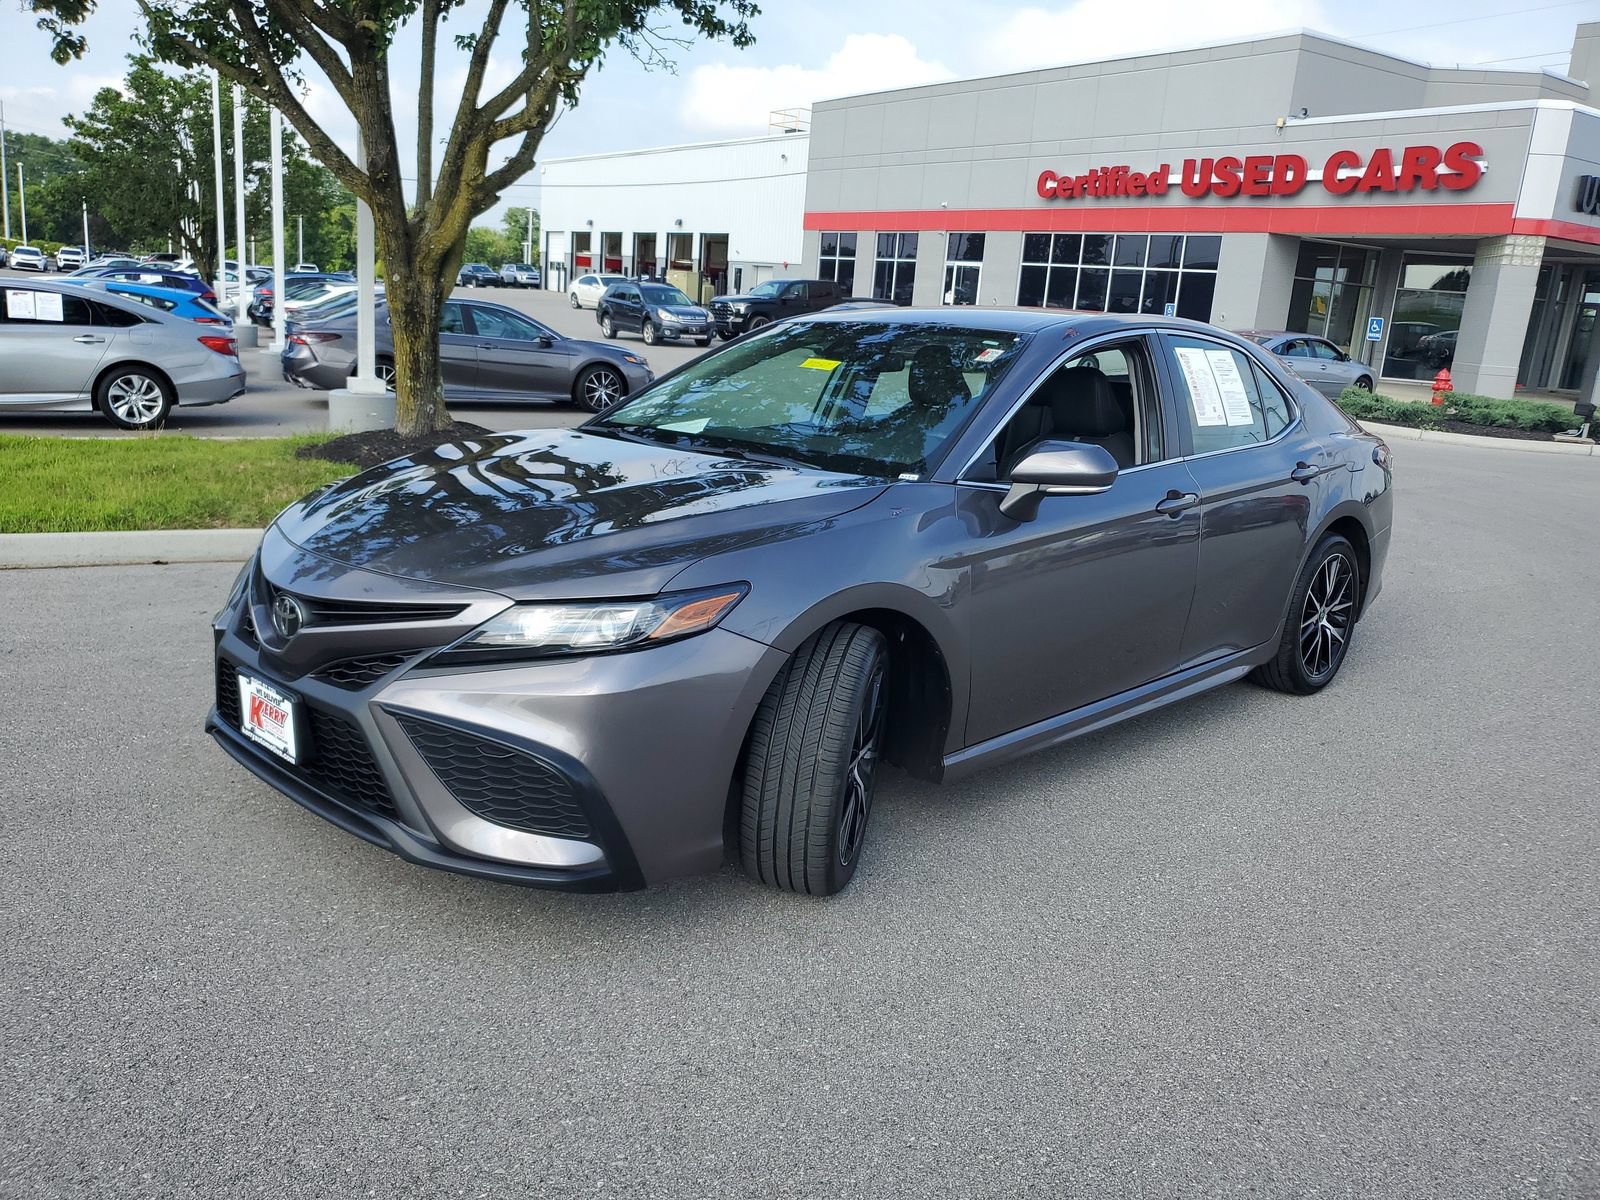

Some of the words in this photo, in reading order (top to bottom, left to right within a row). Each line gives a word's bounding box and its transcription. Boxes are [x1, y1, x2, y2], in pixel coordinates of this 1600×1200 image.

[1037, 163, 1170, 198] Certified
[1181, 154, 1308, 198] USED
[1322, 141, 1484, 195] CARS
[250, 694, 287, 728] KERRY
